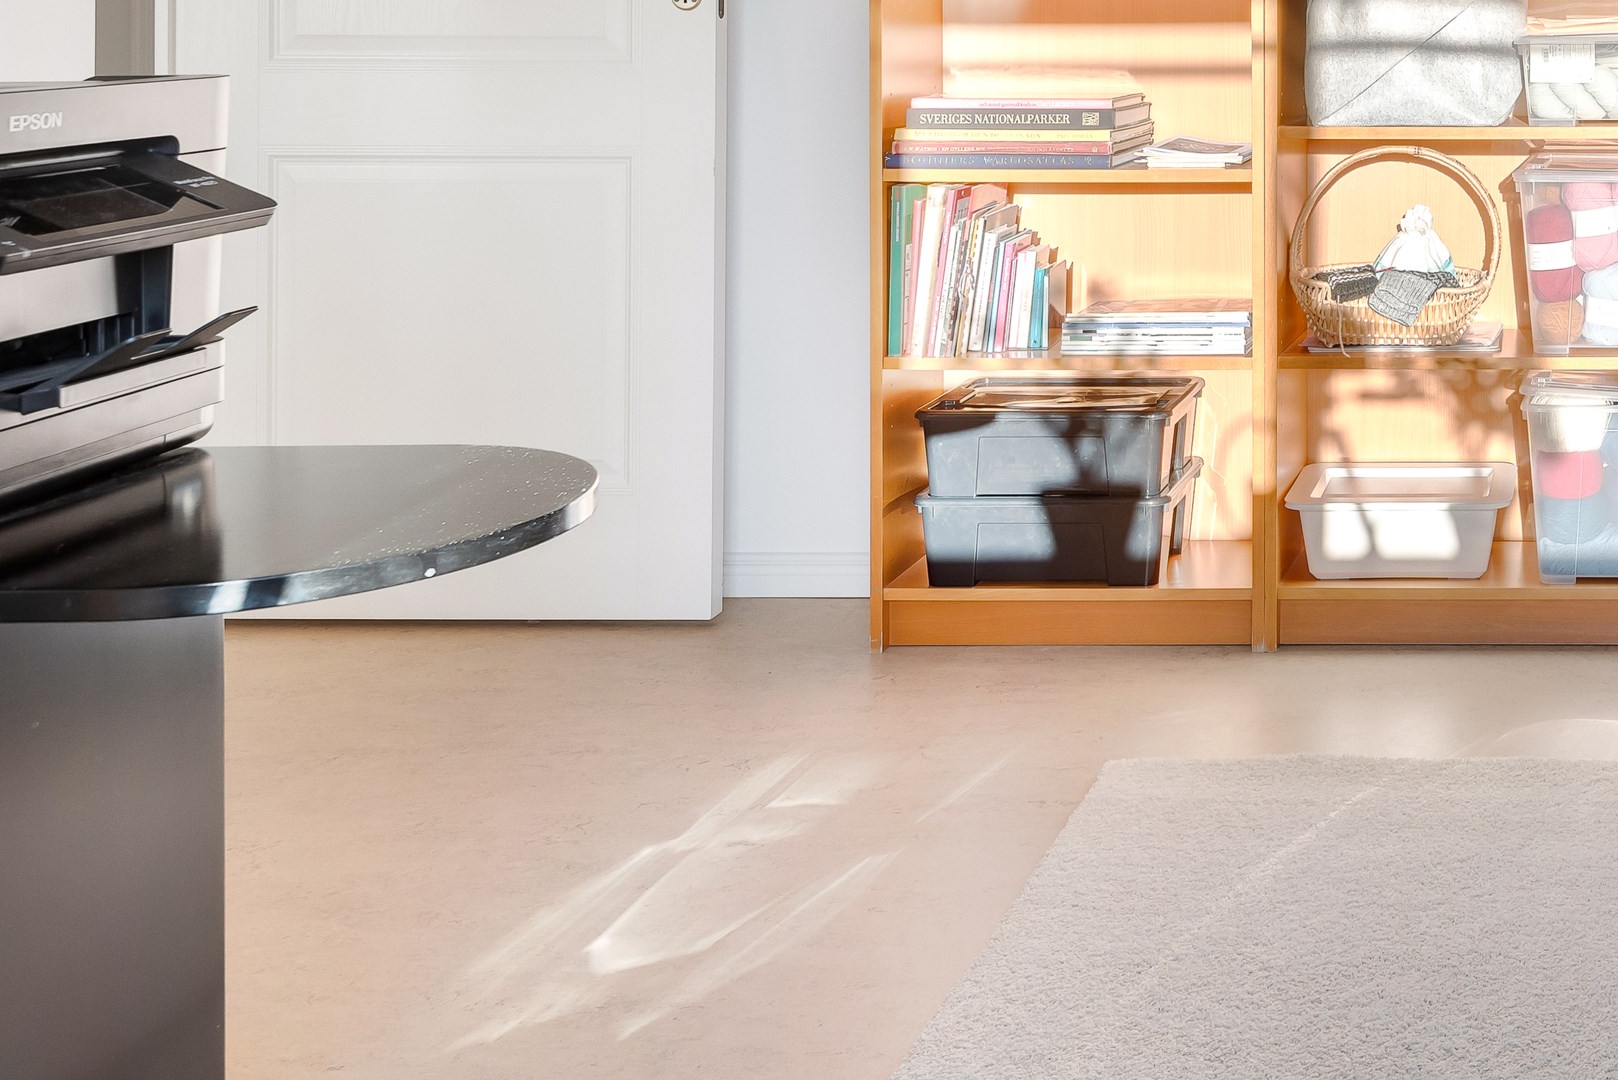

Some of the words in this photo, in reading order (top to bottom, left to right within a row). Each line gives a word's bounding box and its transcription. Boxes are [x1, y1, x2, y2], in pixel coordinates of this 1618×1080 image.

[9, 112, 64, 132] EPSON
[919, 113, 973, 125] SVERIGES
[974, 113, 1071, 126] NATIONALPARKER
